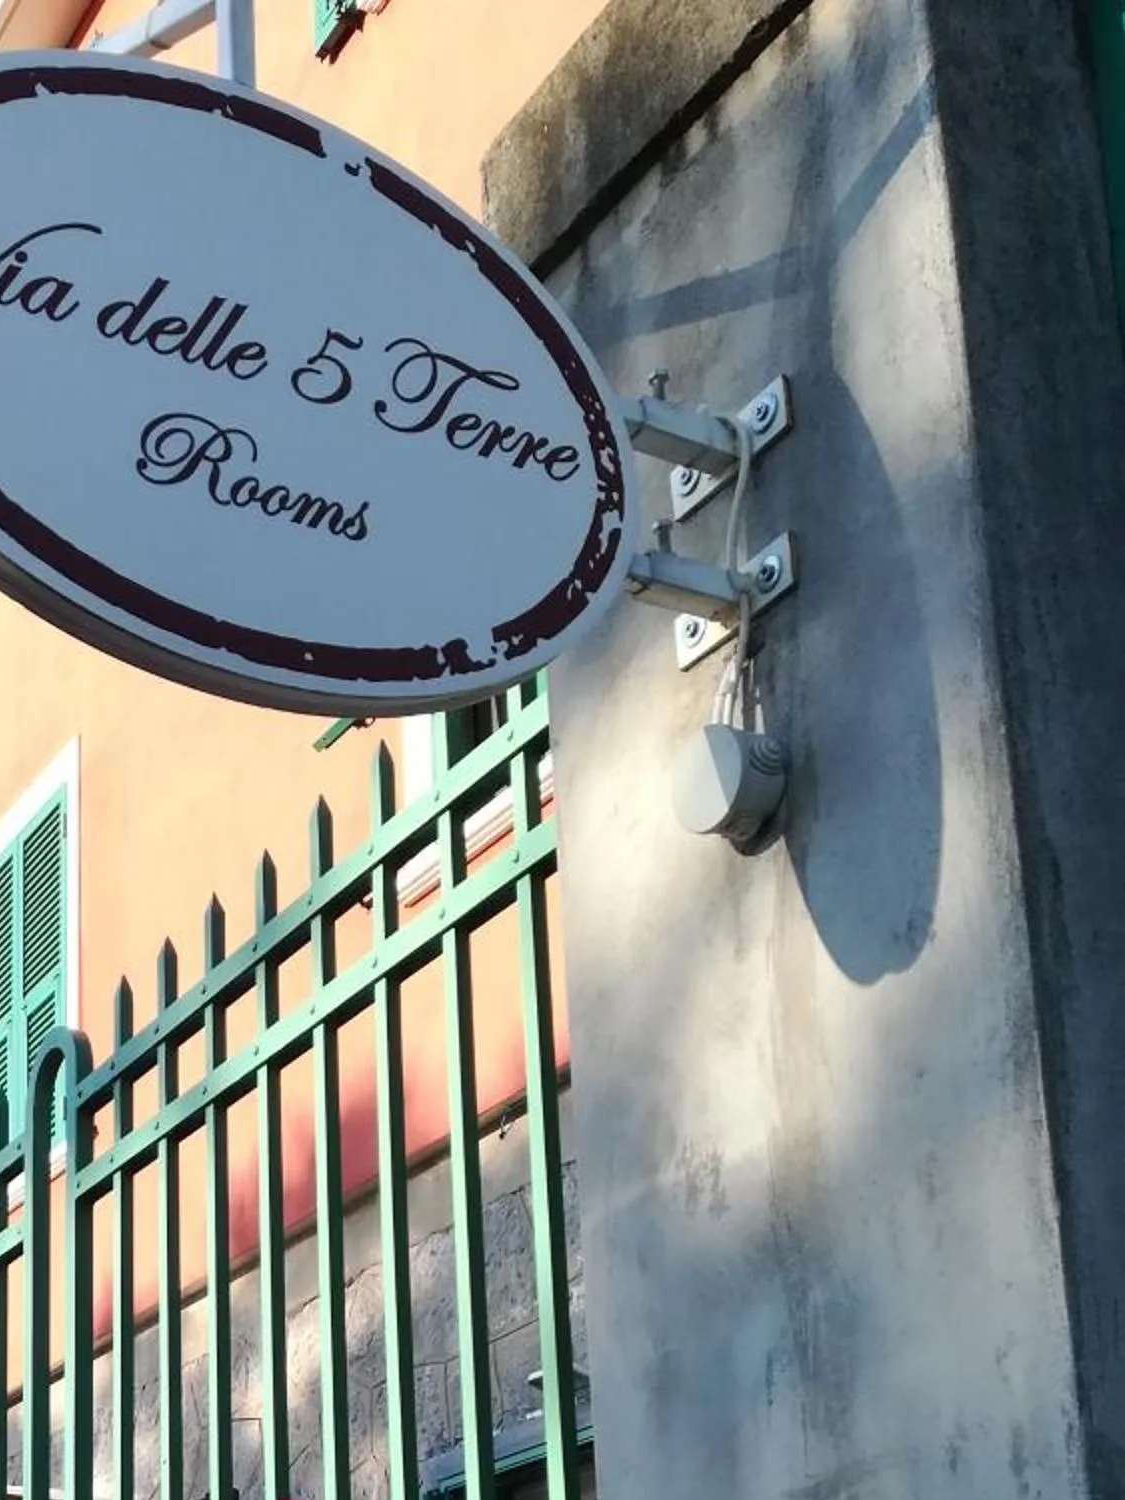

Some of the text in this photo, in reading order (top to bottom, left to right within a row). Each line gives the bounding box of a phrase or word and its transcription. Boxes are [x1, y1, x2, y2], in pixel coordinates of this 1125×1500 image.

[95, 278, 268, 381] delle
[290, 328, 363, 404] 5
[373, 336, 581, 482] Terre
[134, 412, 370, 543] Rooms
